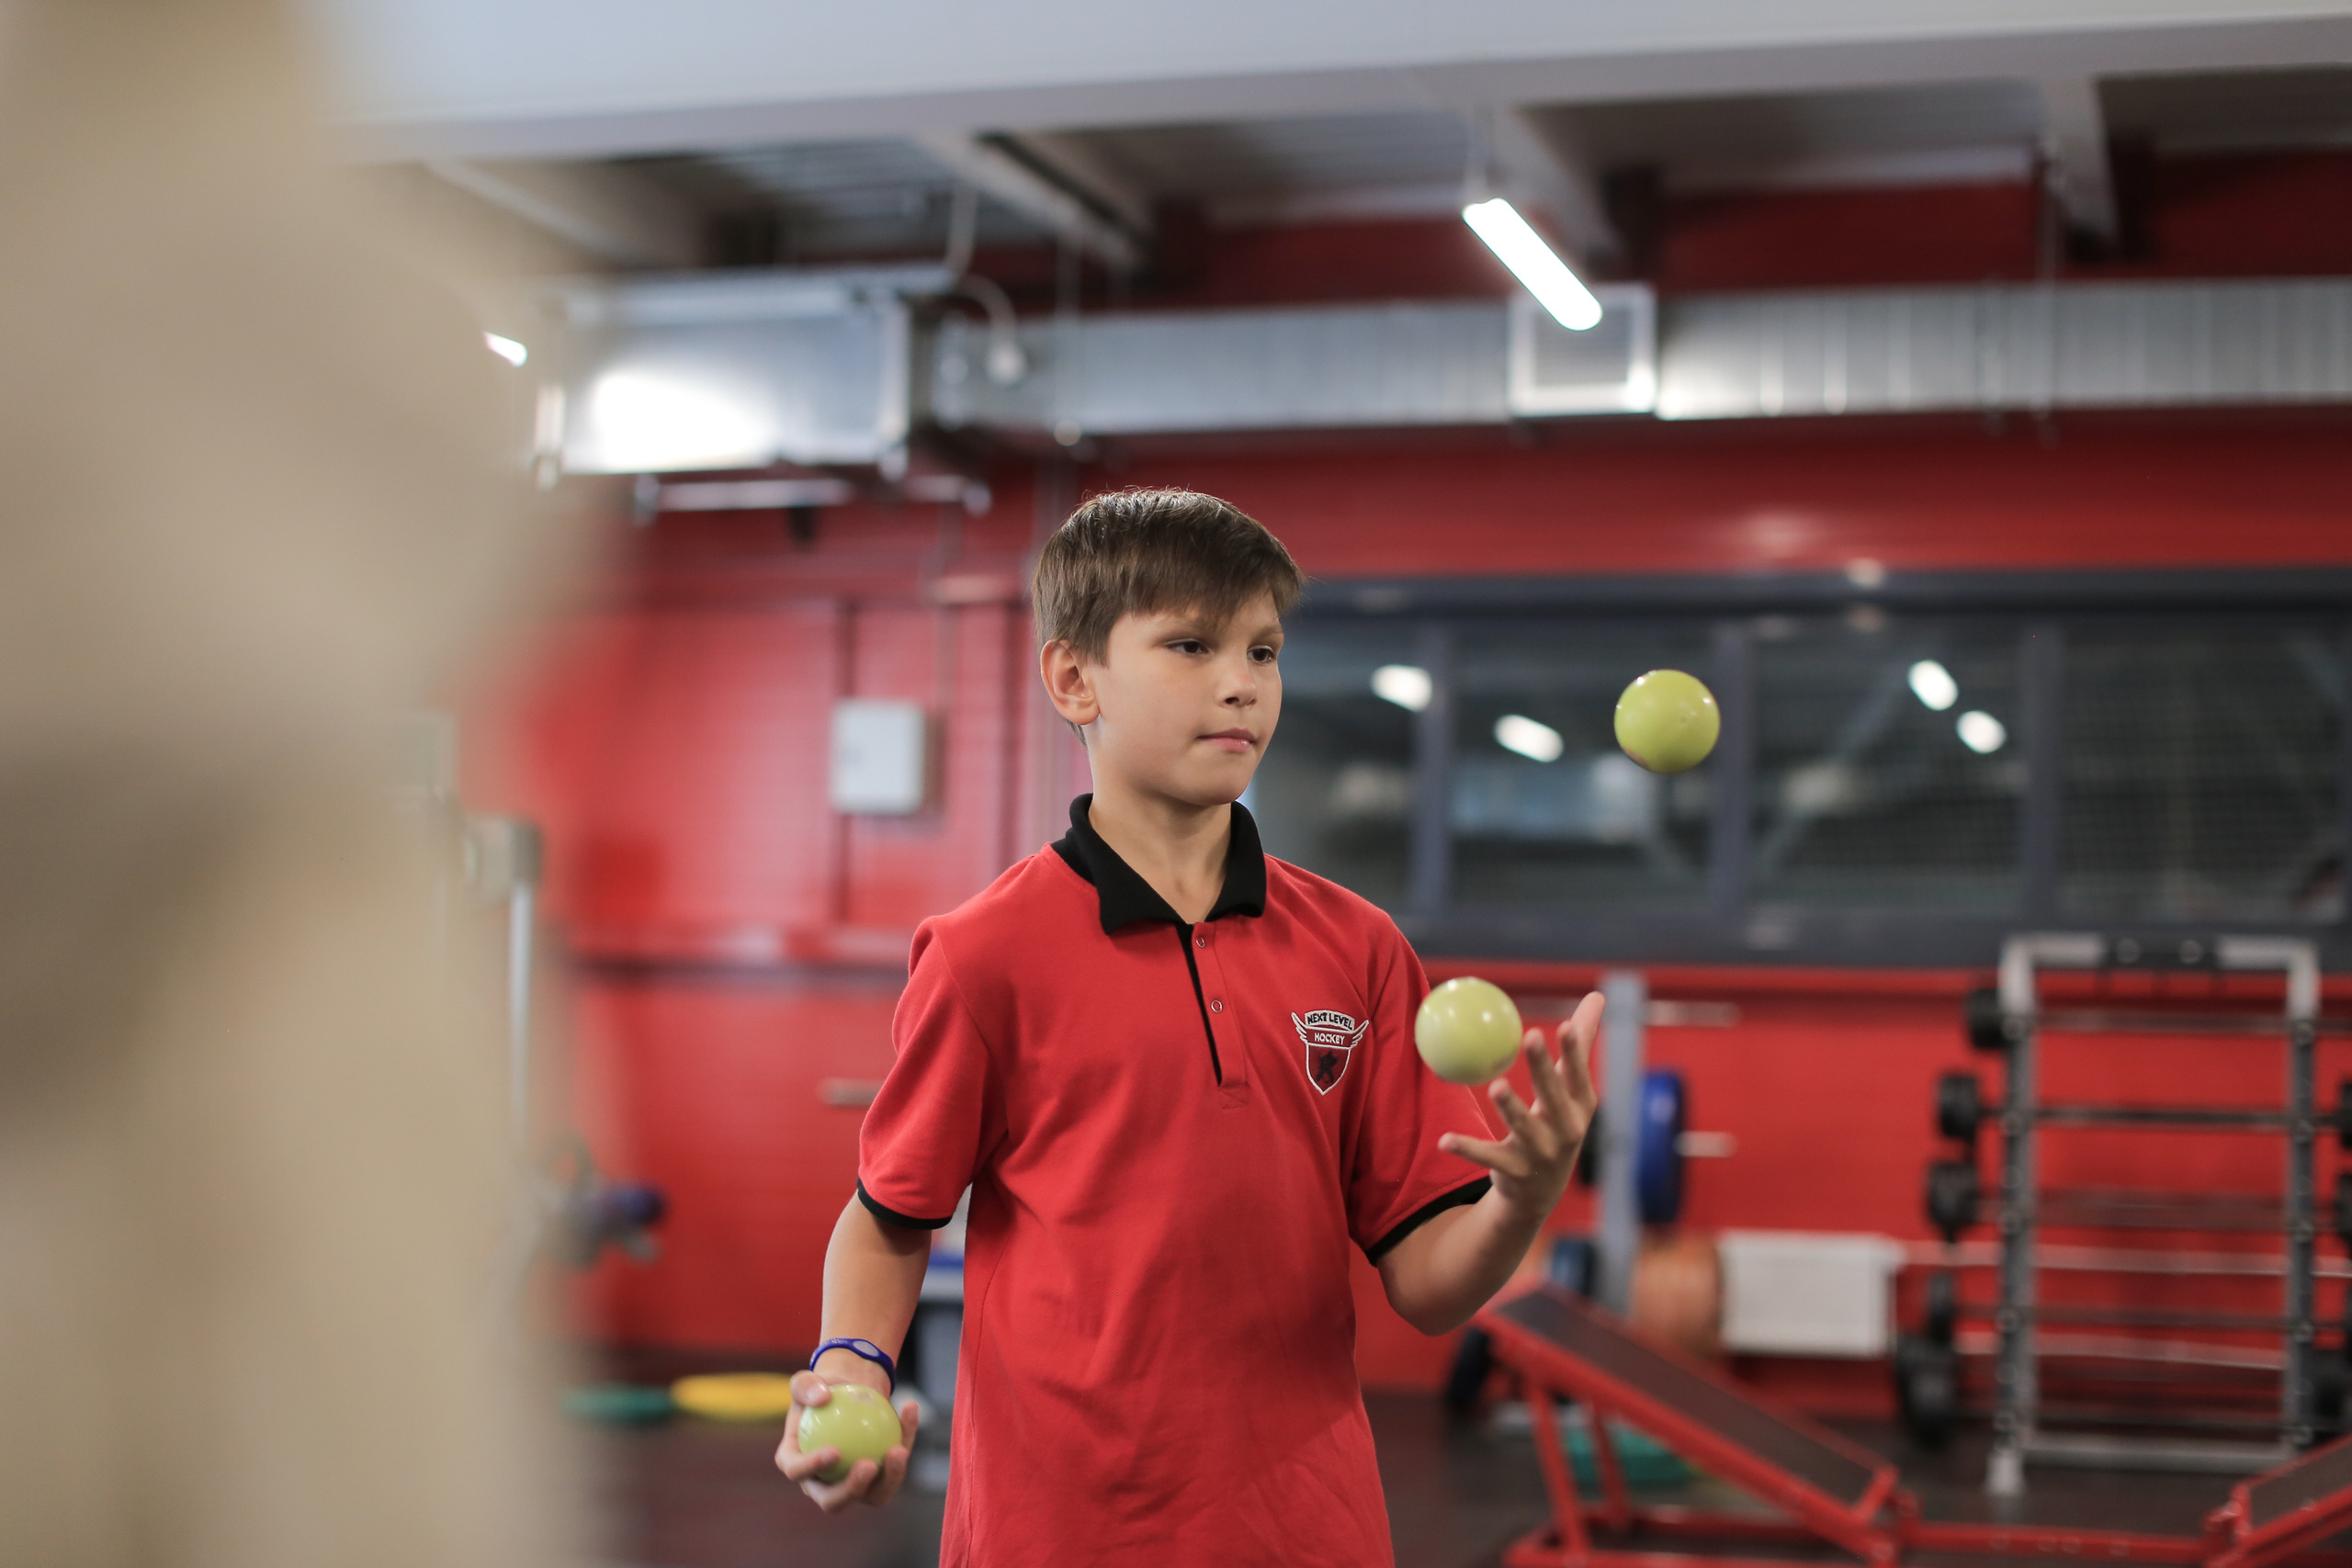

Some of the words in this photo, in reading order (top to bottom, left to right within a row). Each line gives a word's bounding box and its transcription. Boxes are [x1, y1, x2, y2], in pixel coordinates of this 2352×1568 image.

[1307, 1012, 1327, 1024] NEXT
[1329, 1013, 1352, 1030] LEVEL
[1314, 1032, 1345, 1044] HOCKEY
